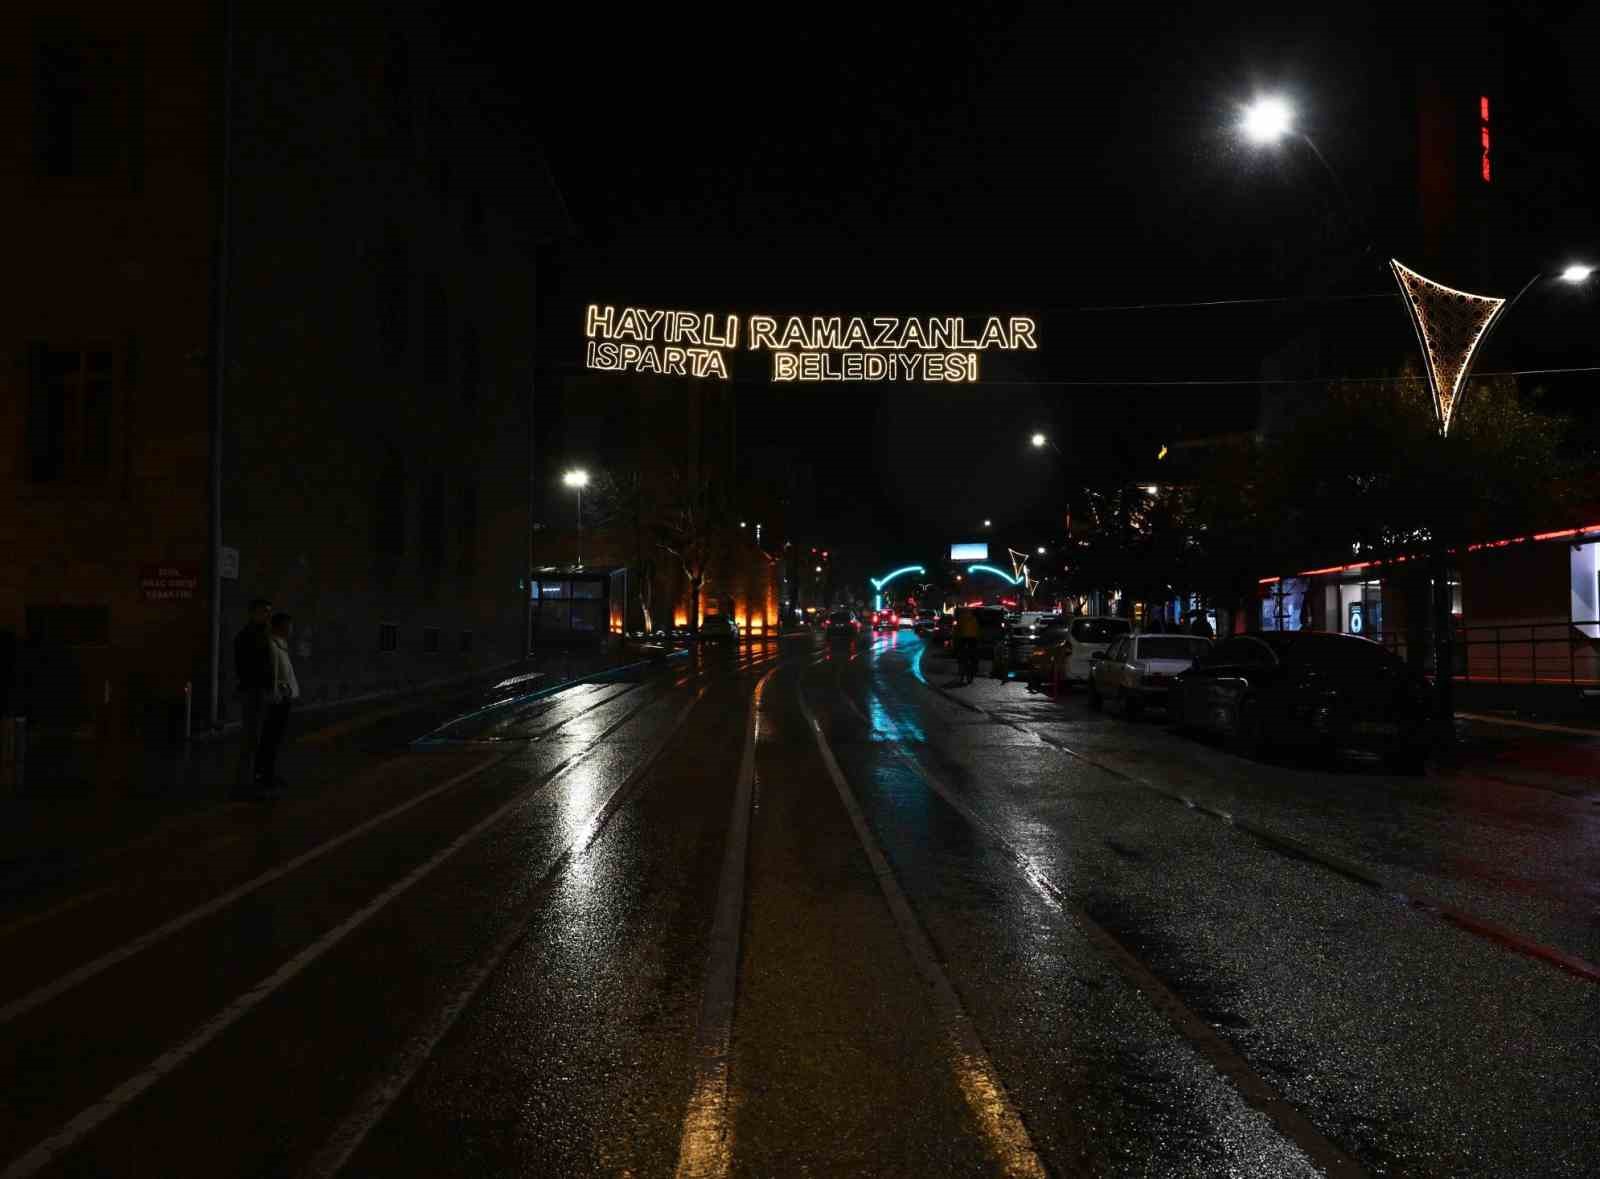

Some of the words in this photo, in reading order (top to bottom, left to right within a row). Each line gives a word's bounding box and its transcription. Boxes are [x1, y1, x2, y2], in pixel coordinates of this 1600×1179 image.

[586, 304, 739, 349] HAYIRLI
[749, 315, 1038, 351] RAMAZANLAR
[586, 340, 729, 379] ISPARTA
